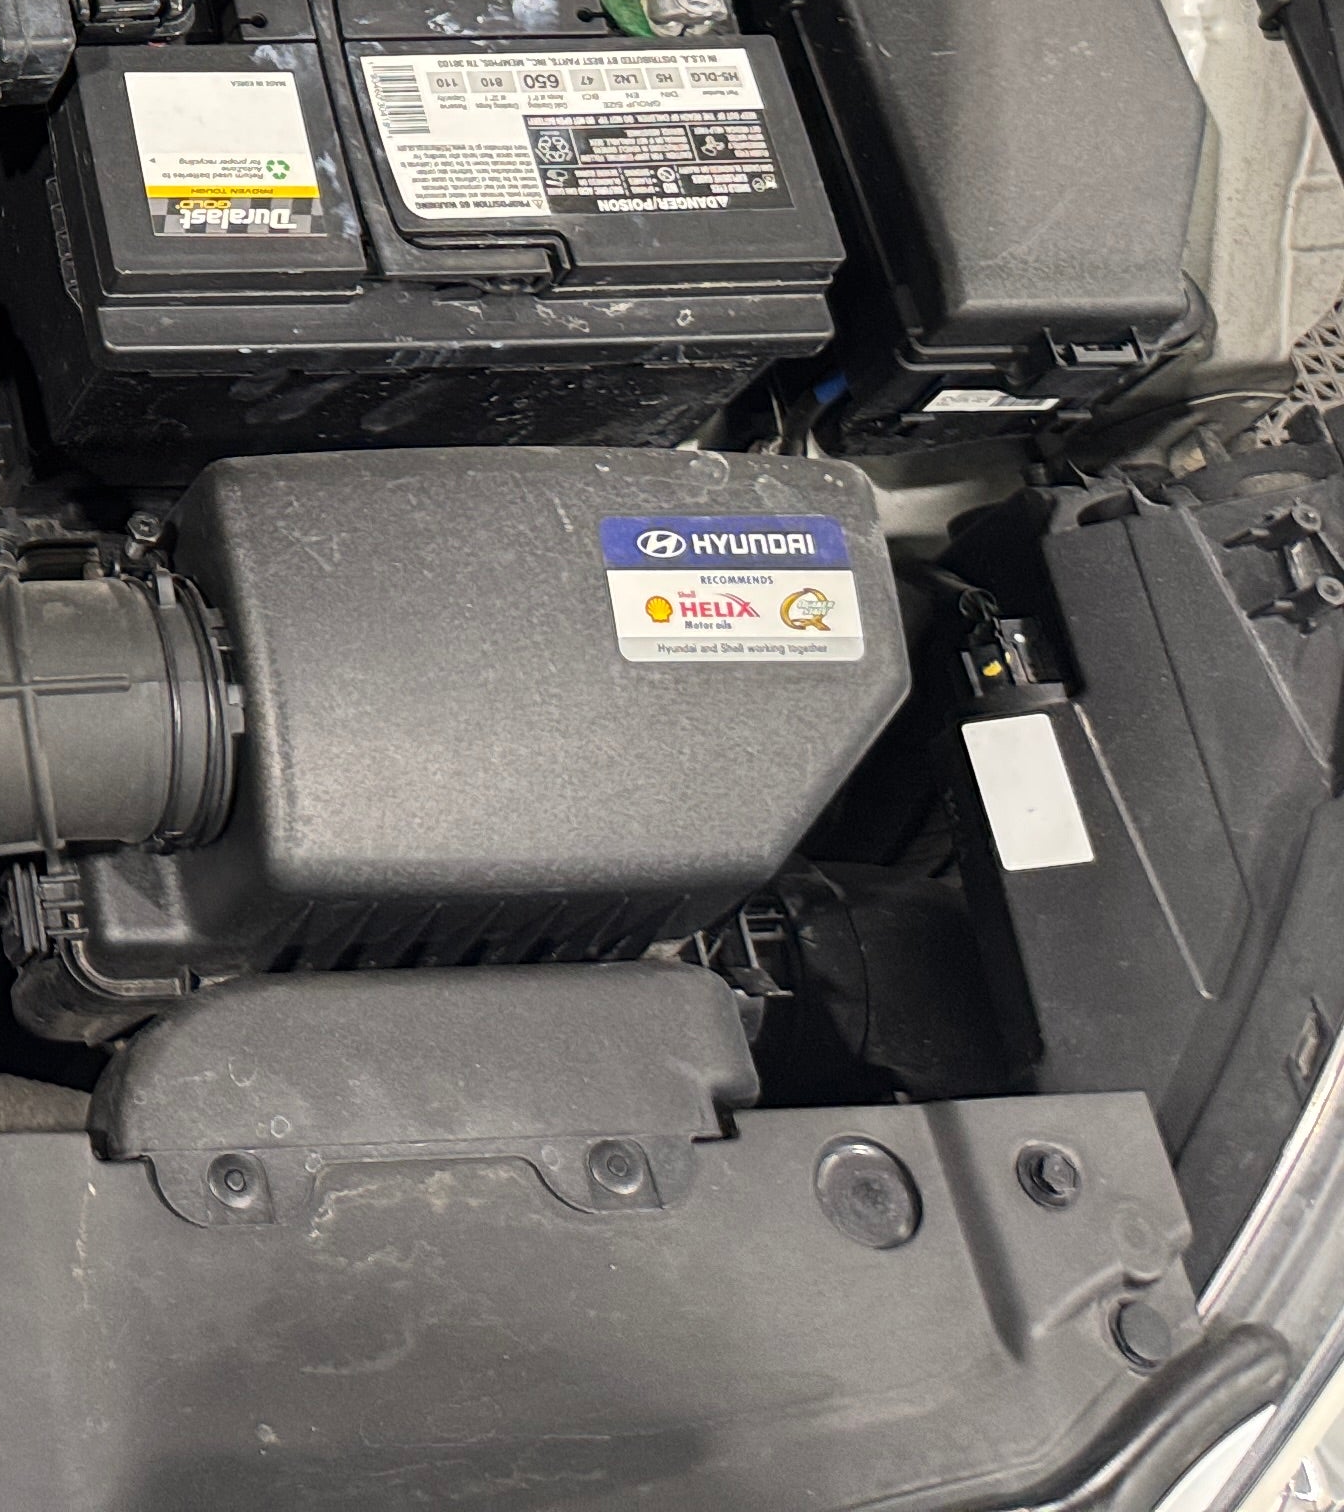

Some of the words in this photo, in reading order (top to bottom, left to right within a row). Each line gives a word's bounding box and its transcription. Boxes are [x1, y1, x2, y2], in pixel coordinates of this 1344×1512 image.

[467, 60, 479, 68] TN
[582, 57, 604, 66] BEST
[606, 57, 618, 65] BY
[620, 55, 676, 64] DISTRIBUTED
[481, 77, 503, 87] 810
[523, 74, 560, 89] 650
[581, 76, 594, 86] 47
[613, 74, 638, 84] LN2
[656, 73, 673, 83] H5
[690, 71, 739, 83] H5-DLG
[437, 78, 458, 88] 110
[602, 101, 623, 109] SIZE
[626, 100, 661, 108] GROUP
[179, 157, 217, 166] recycling
[218, 157, 247, 166] proper
[173, 172, 210, 180] batteries
[212, 172, 233, 180] used
[235, 172, 264, 180] Return
[597, 197, 716, 211] DANGER/POISON
[179, 208, 298, 229] Duralast
[692, 533, 816, 555] HYUNDAI
[700, 575, 774, 585] RECOMMENDS
[679, 601, 756, 618] HELIX
[684, 620, 714, 630] Motor
[715, 620, 732, 630] oils
[658, 643, 697, 654] Hyundai
[700, 644, 718, 653] and
[721, 642, 744, 653] Shell
[746, 643, 785, 655] working
[787, 643, 828, 655] together
